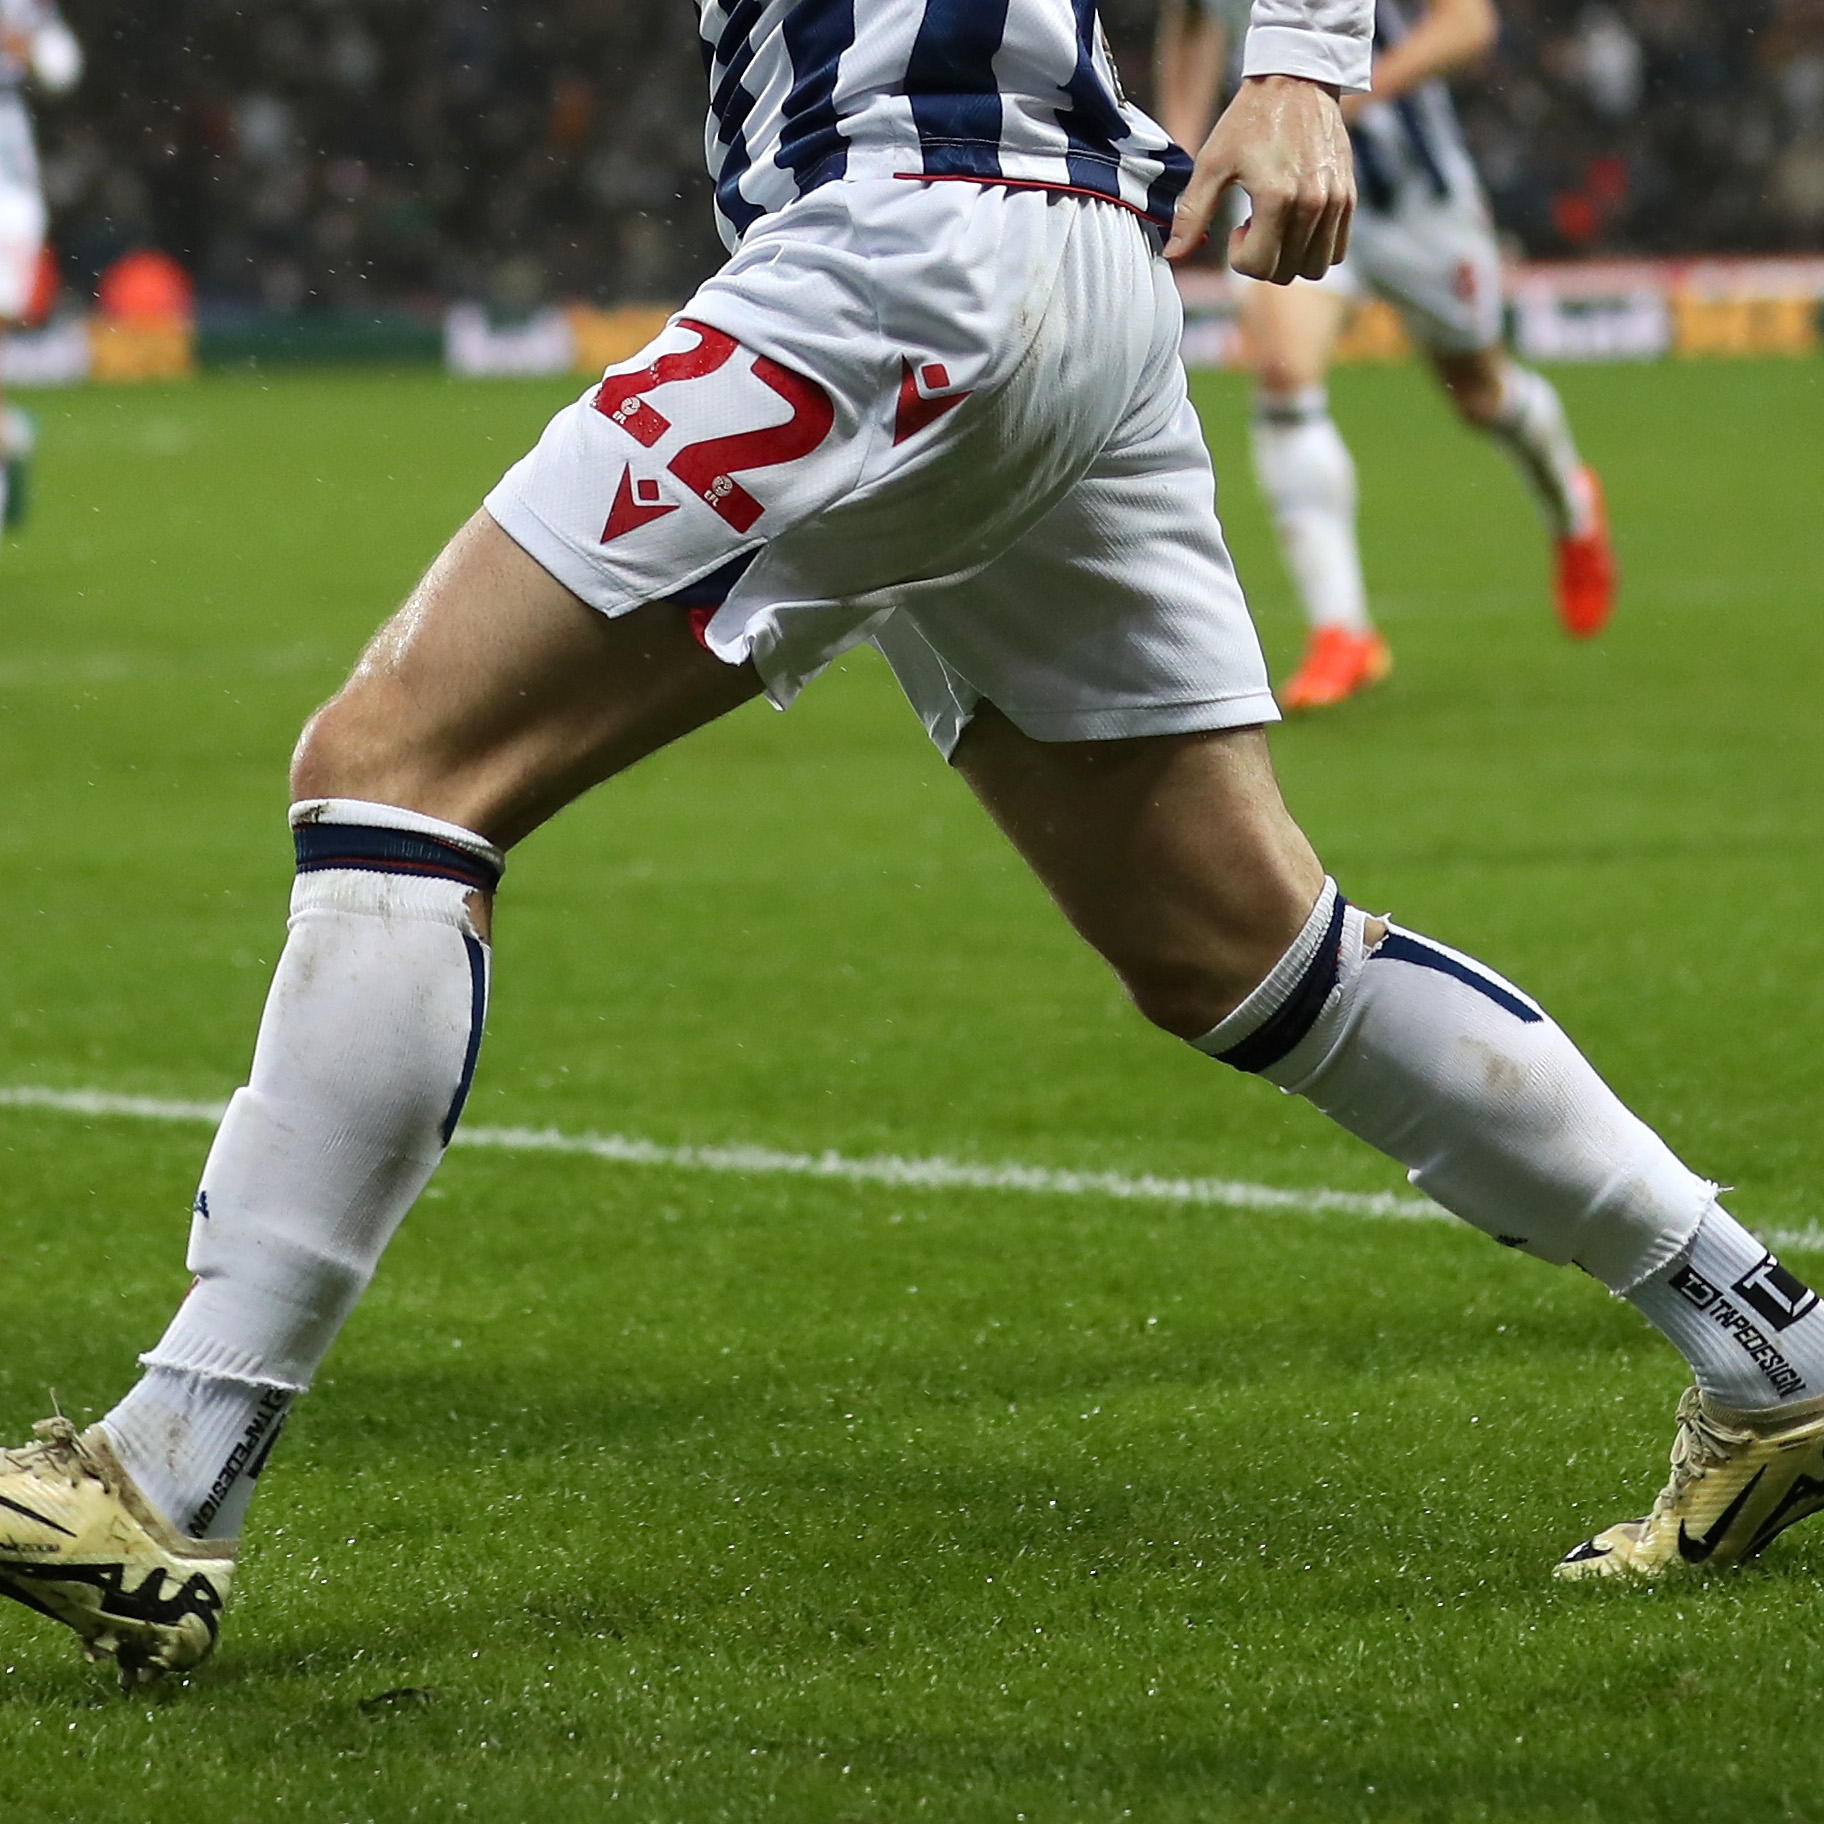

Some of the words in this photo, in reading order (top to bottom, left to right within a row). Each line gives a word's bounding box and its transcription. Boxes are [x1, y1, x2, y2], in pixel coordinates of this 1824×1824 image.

[590, 317, 835, 534] 22
[612, 410, 627, 425] EFL
[703, 489, 721, 508] EFL
[1710, 1297, 1807, 1399] TAPEDESIGN
